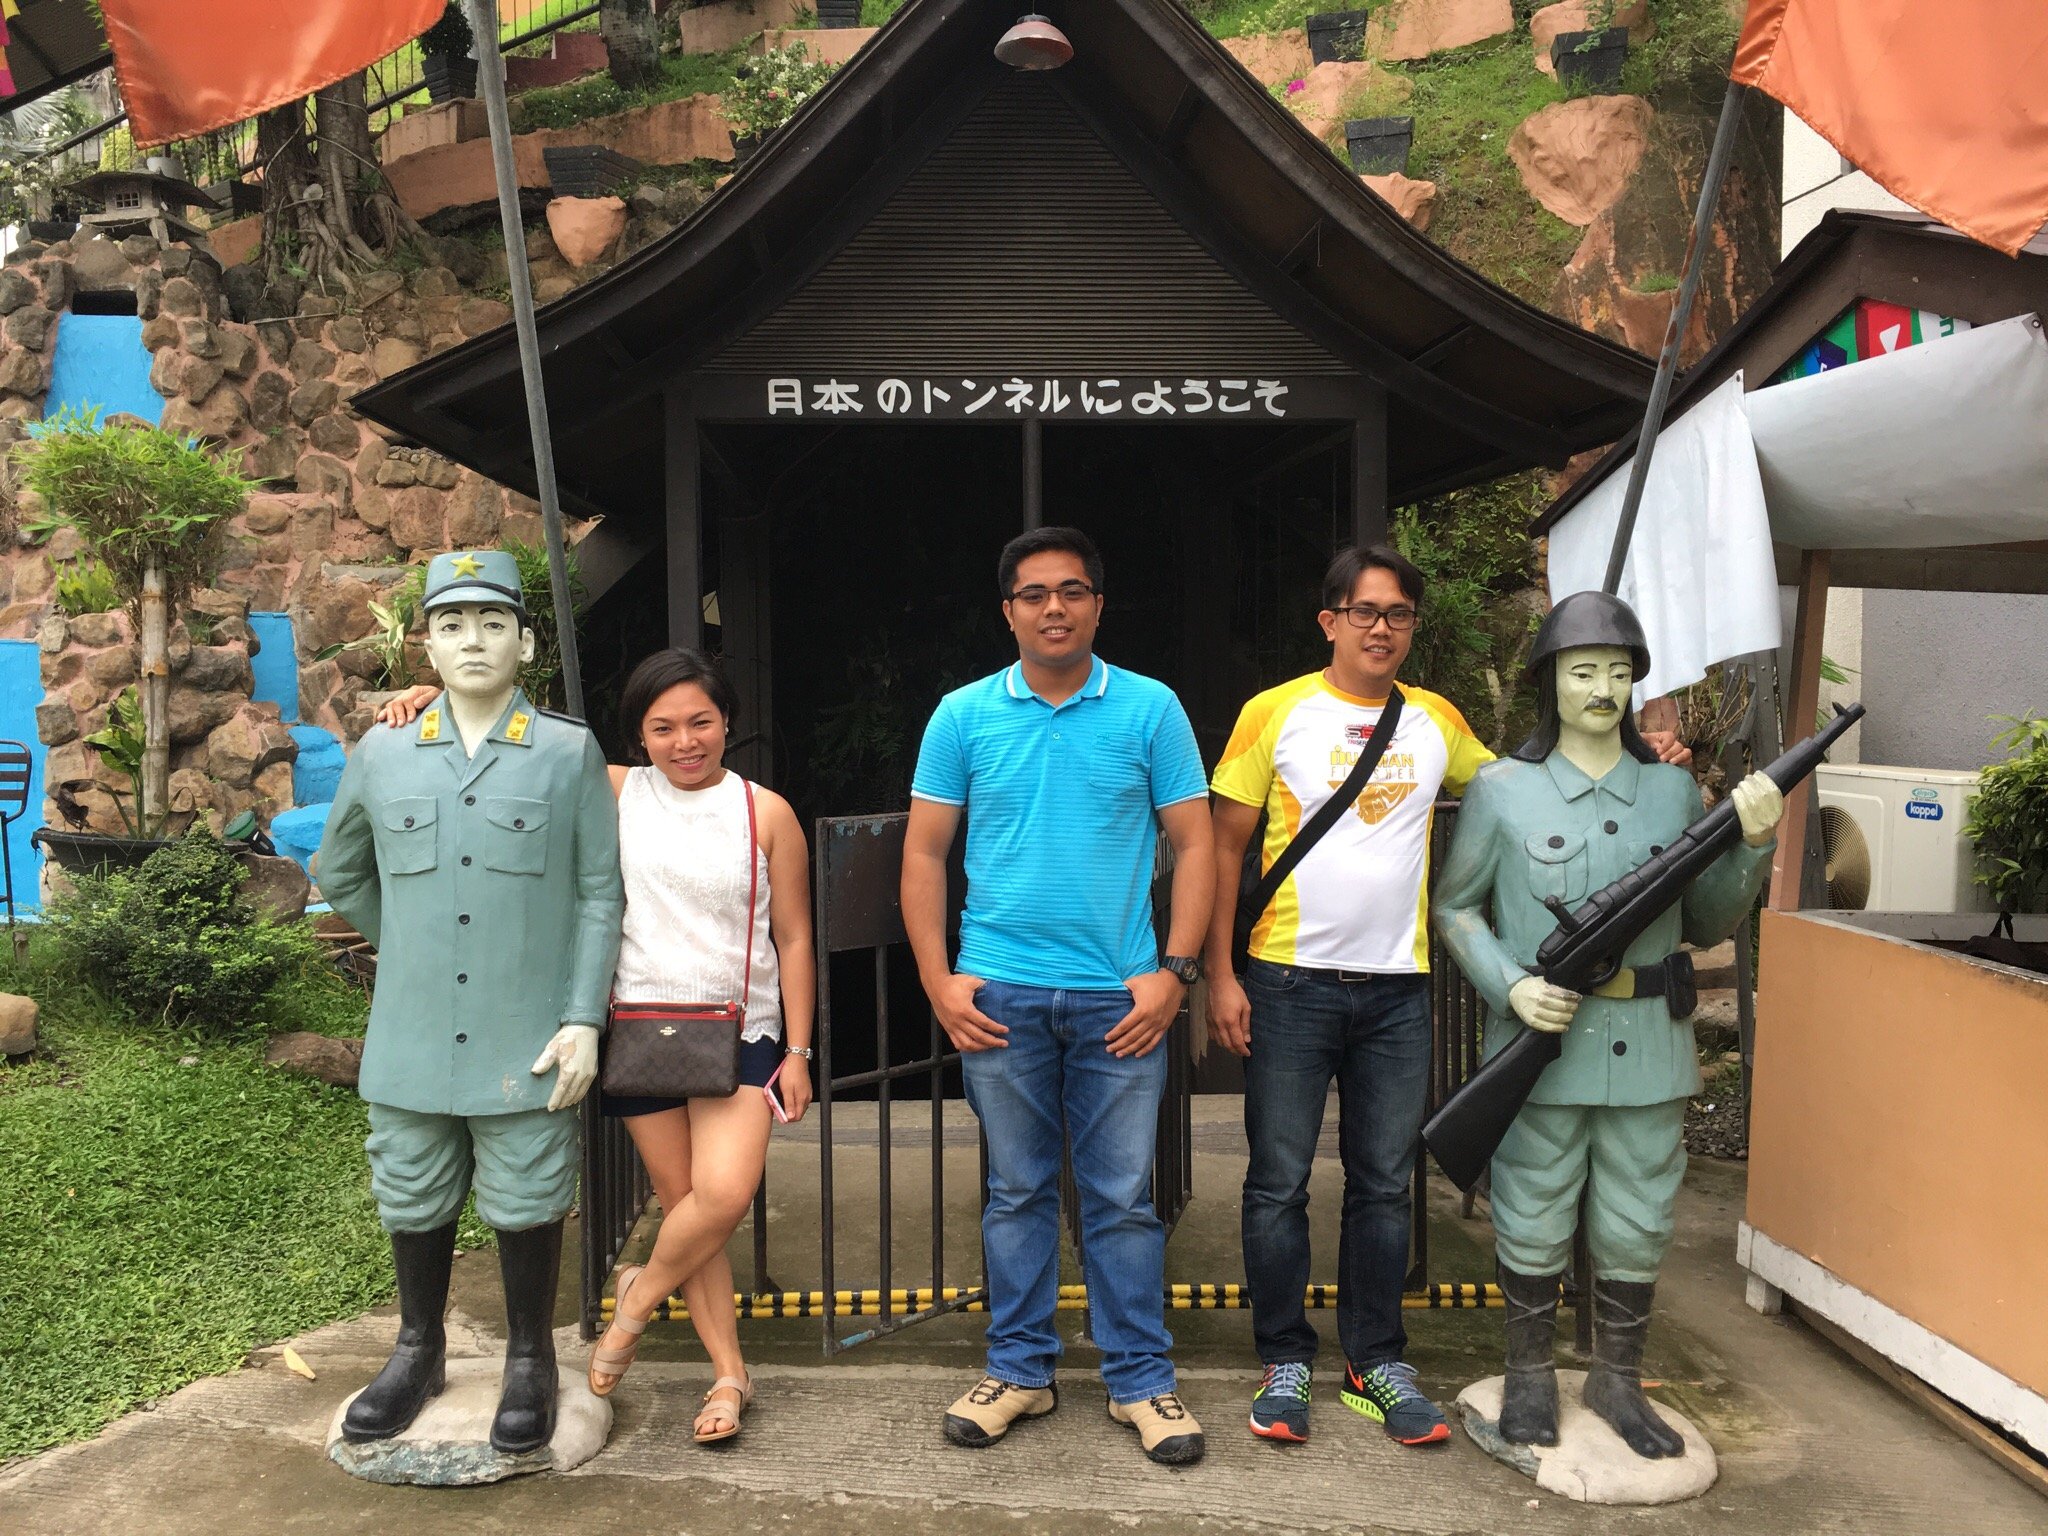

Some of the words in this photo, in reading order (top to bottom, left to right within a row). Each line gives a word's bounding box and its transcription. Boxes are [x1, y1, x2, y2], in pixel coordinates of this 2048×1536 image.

[767, 377, 1289, 416] 日本のトンネルにようこそ
[1330, 766, 1415, 780] FISHER
[1910, 803, 1939, 819] koppel
